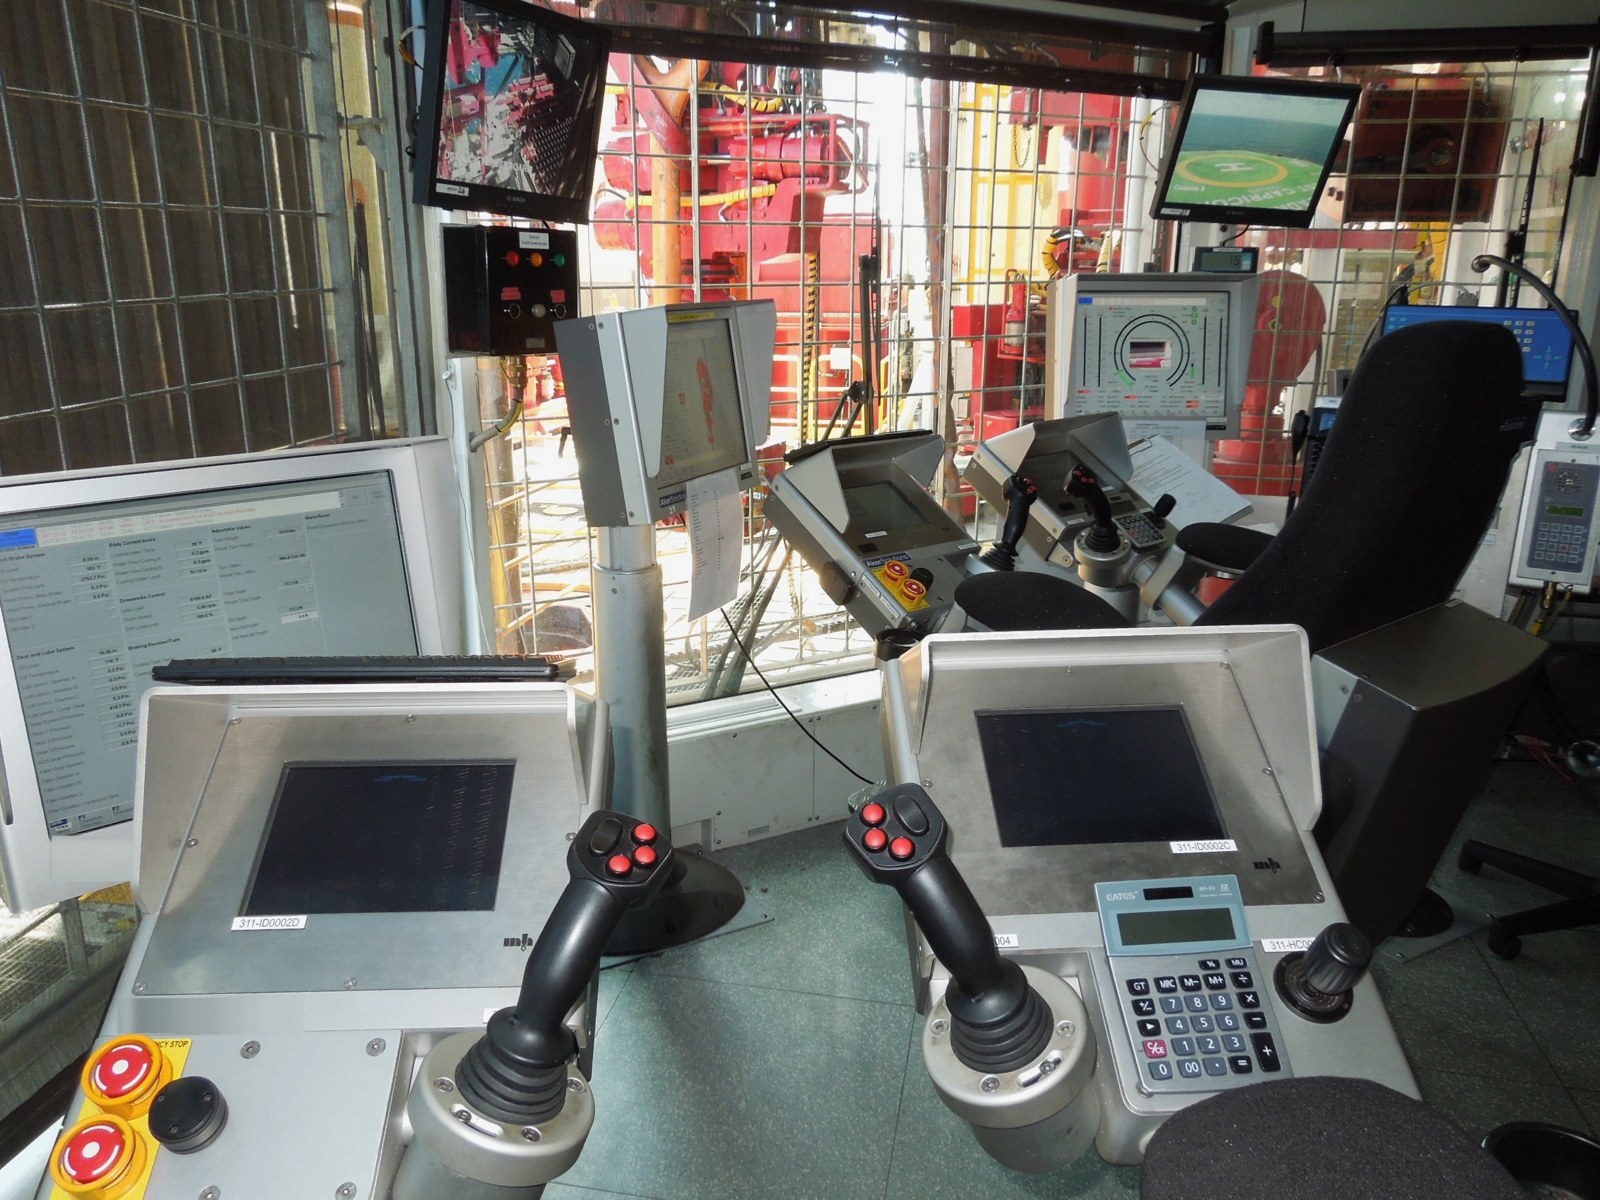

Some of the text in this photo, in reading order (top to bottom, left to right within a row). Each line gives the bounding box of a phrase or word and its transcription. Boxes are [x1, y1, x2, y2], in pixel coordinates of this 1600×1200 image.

[1176, 842, 1230, 852] 311-ID0002C
[240, 918, 300, 928] 311-ID0002D
[1134, 982, 1146, 990] GT
[1160, 980, 1176, 988] MRC
[1169, 1000, 1175, 1008] 7
[1194, 998, 1202, 1008] 8
[1218, 996, 1226, 1006] 9
[1176, 1020, 1183, 1029] 4
[1200, 1018, 1208, 1028] 5
[1224, 1016, 1232, 1026] 6
[1183, 1041, 1188, 1051] 1
[1207, 1038, 1214, 1048] 2
[1232, 1036, 1240, 1047] 3
[1160, 1064, 1167, 1075] 0
[1185, 1062, 1198, 1072] 00
